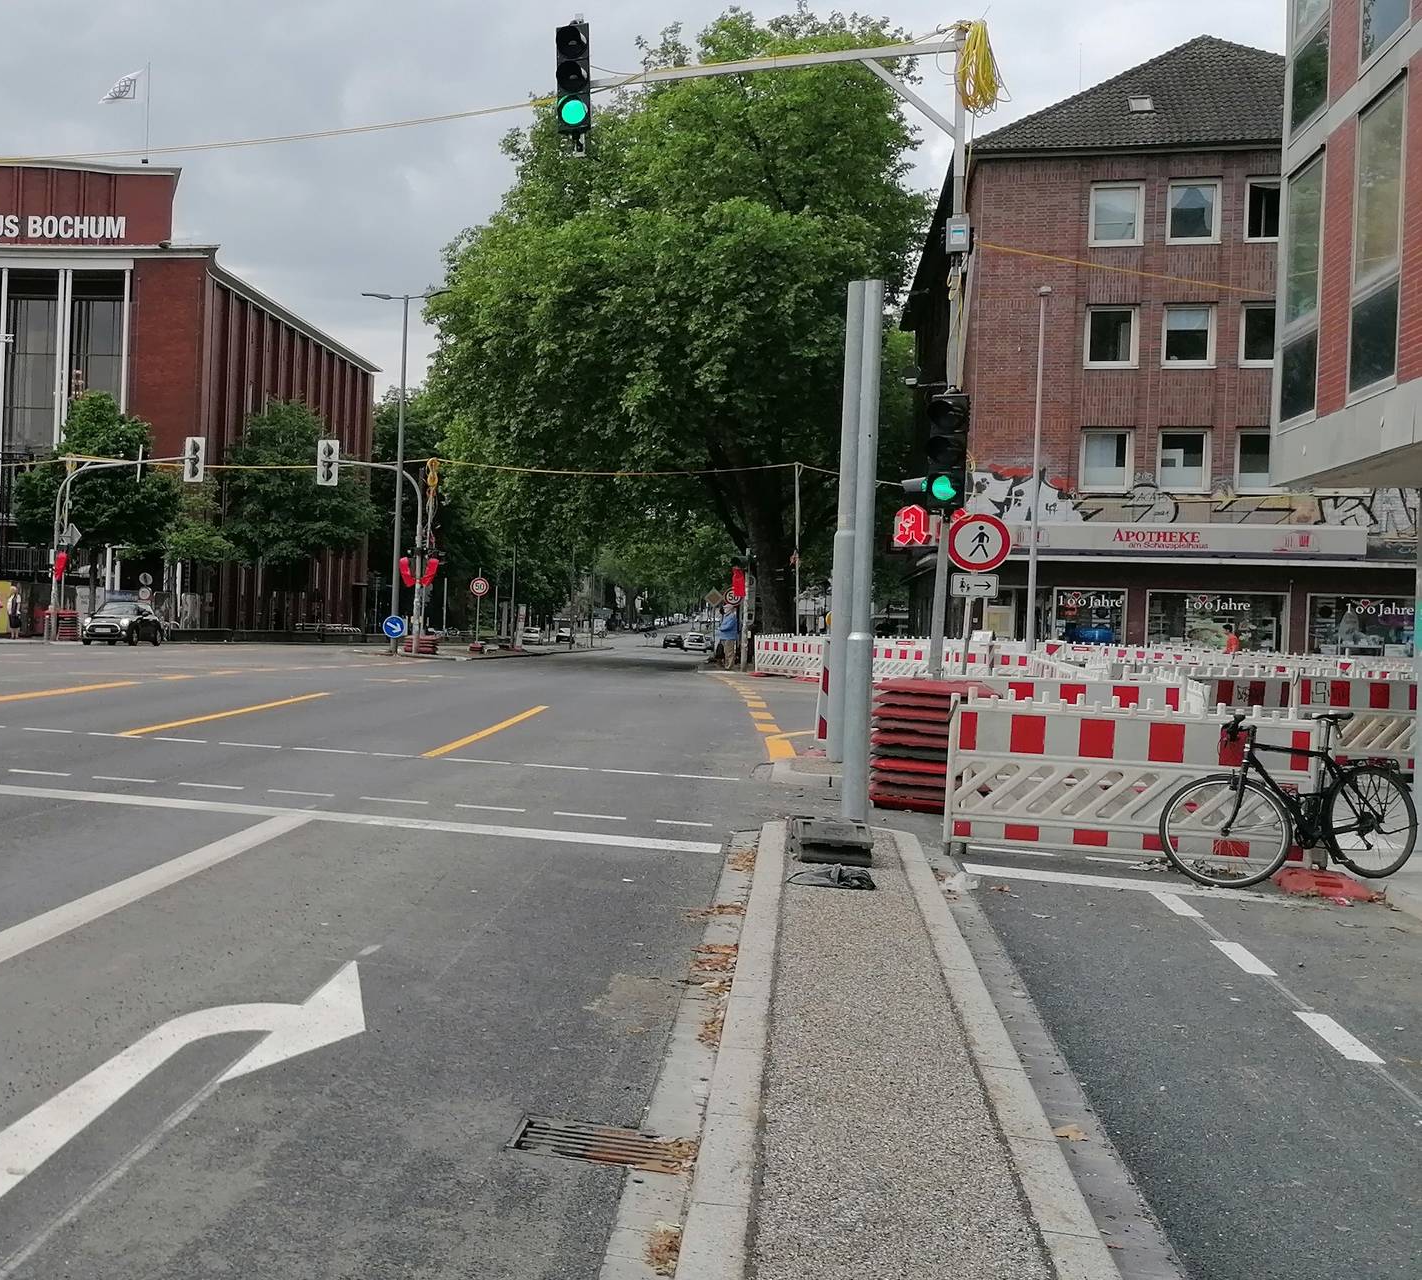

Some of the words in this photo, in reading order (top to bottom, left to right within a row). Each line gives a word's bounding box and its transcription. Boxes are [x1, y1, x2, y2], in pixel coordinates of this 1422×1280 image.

[27, 215, 126, 239] BOCHUM
[1112, 527, 1201, 543] APOTHEKE
[1143, 542, 1209, 550] Schauspielhaus
[474, 582, 484, 591] 50
[1088, 594, 1124, 608] Jahre
[1215, 597, 1251, 611] Jahre
[1377, 602, 1415, 617] Jahre
